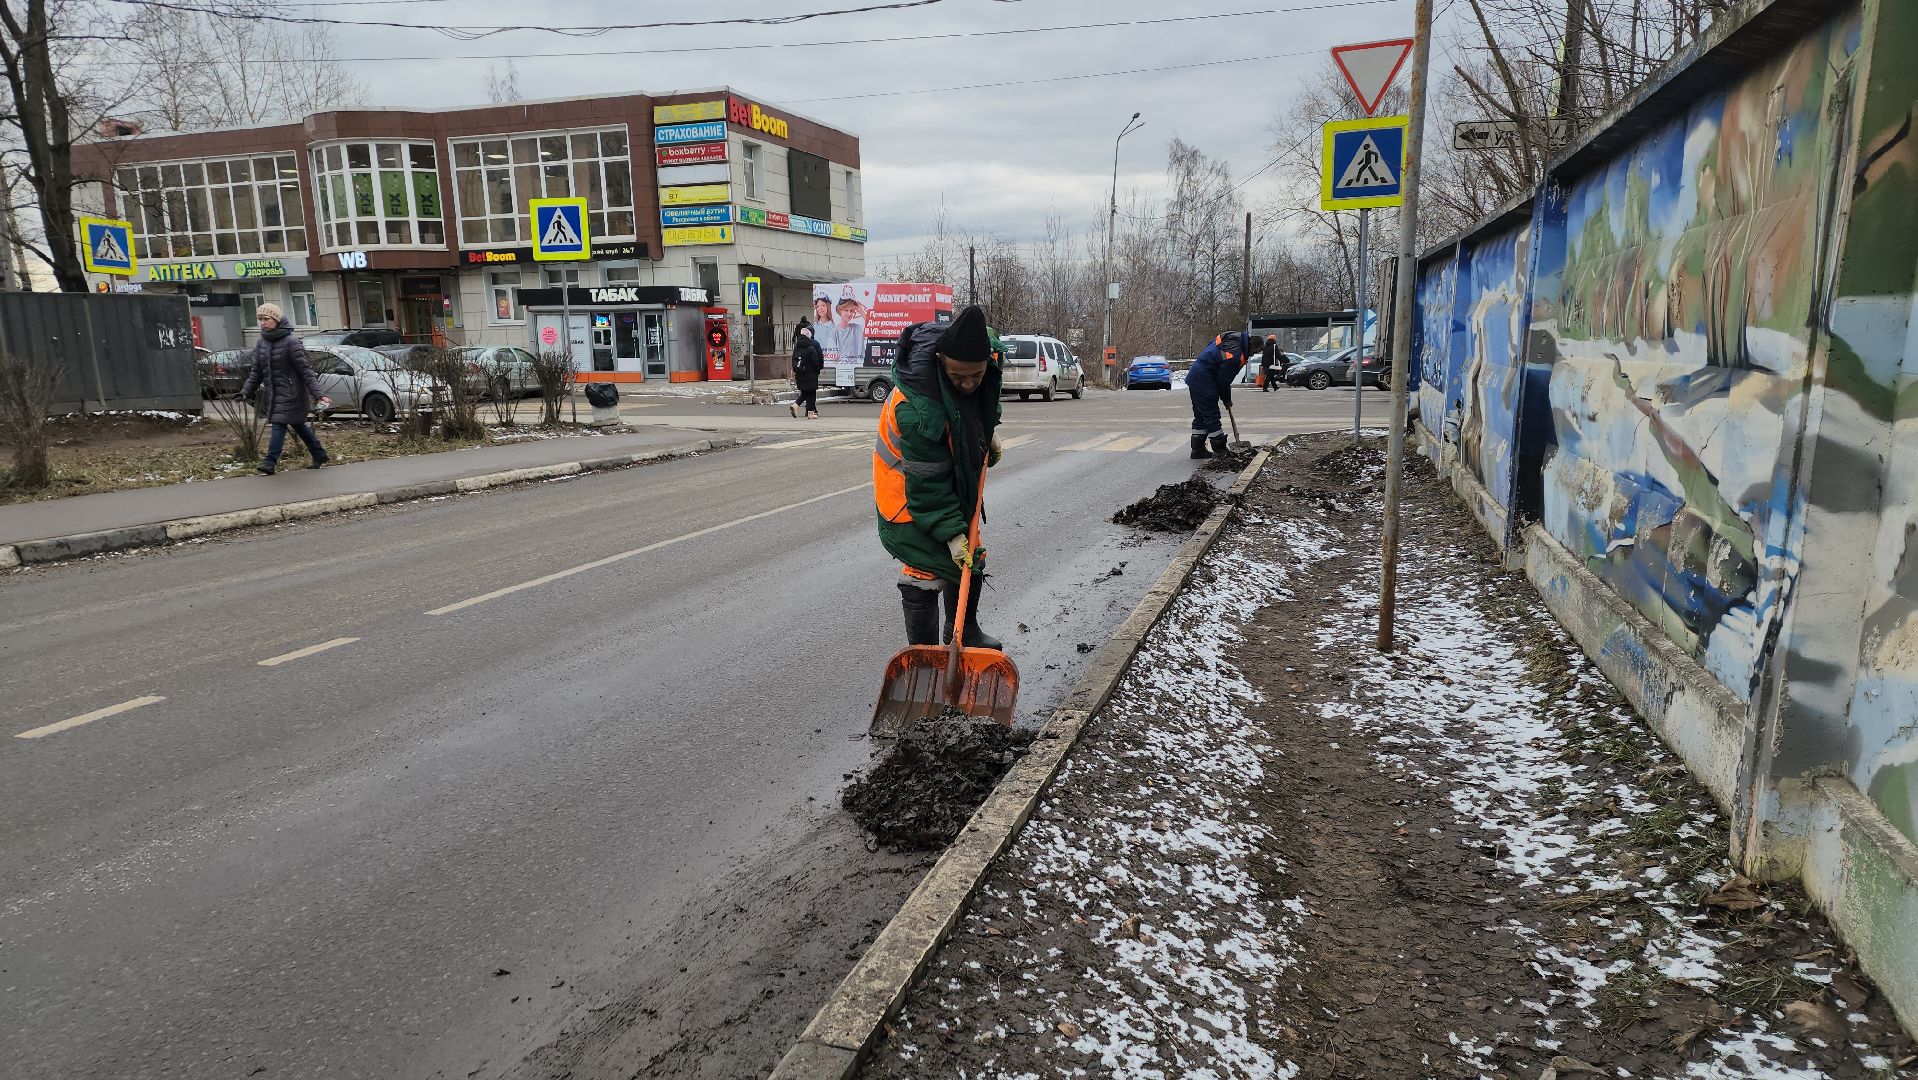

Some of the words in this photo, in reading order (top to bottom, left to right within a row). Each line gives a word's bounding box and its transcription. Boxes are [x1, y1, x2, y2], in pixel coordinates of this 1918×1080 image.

[729, 96, 788, 139] BetBoom
[658, 124, 723, 141] СТРАХОВАНИЕ
[668, 146, 706, 157] boxberry
[361, 193, 373, 215] FIX
[389, 193, 402, 215] FIX
[421, 193, 434, 215] FIX
[706, 208, 727, 216] БУТИК
[246, 260, 281, 269] ПЛАНЕТА
[338, 252, 368, 269] WB
[468, 252, 516, 263] BetBoom
[148, 263, 216, 281] АПТЕКА
[246, 267, 284, 277] ЗДОРОВЬЯ
[589, 287, 640, 303] ТАБАК
[679, 287, 708, 303] ТАБАК
[878, 293, 932, 304] WARPOINT
